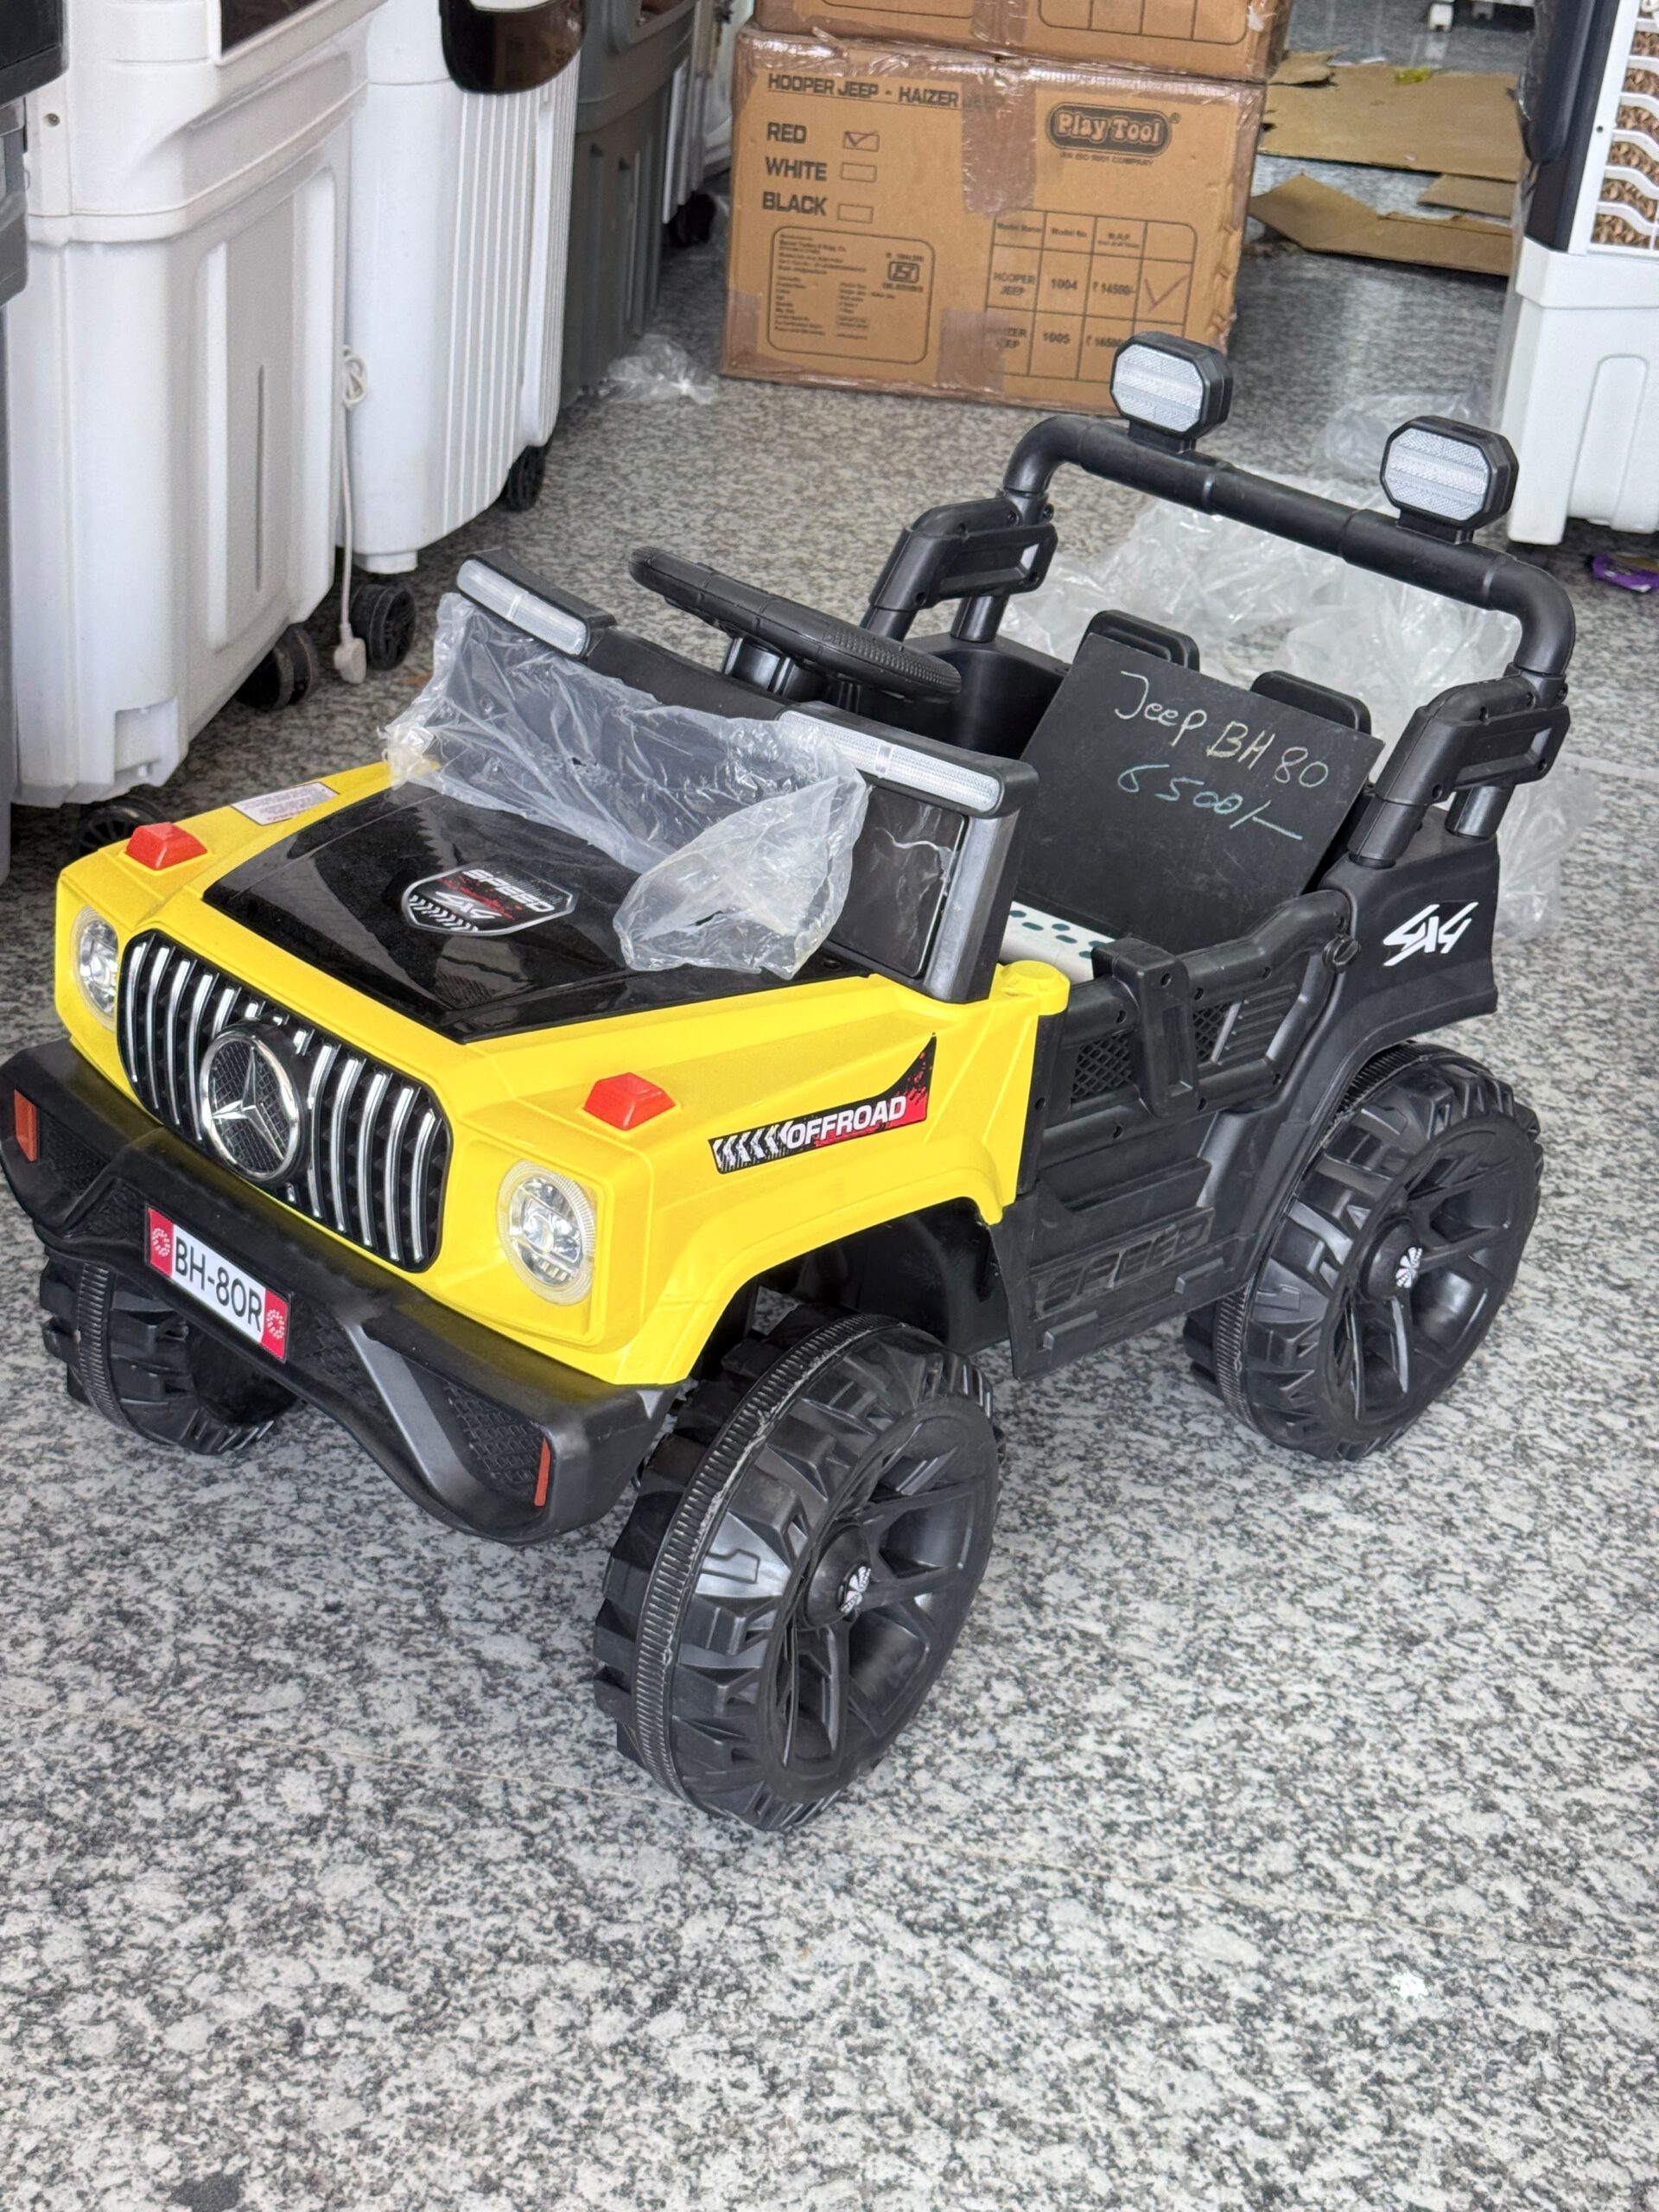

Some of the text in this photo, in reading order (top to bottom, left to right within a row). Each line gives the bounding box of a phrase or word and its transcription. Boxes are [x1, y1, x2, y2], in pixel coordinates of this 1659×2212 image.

[767, 73, 835, 96] HOOPER
[838, 80, 879, 99] JEEP
[899, 86, 960, 108] HAIZER
[766, 122, 807, 144] RED
[1058, 113, 1160, 143] Play Tool
[765, 156, 828, 182] WHITE
[762, 191, 828, 217] BLACK
[994, 271, 1035, 284] HOOPER
[1000, 285, 1025, 296] JEEP
[1051, 278, 1077, 290] 1004
[1043, 332, 1071, 344] 1005
[1206, 721, 1276, 770] BH
[1274, 747, 1330, 788] 80
[462, 868, 556, 912] SPEED
[785, 1095, 907, 1150] OFFROAD
[175, 1236, 263, 1332] BH-80R
